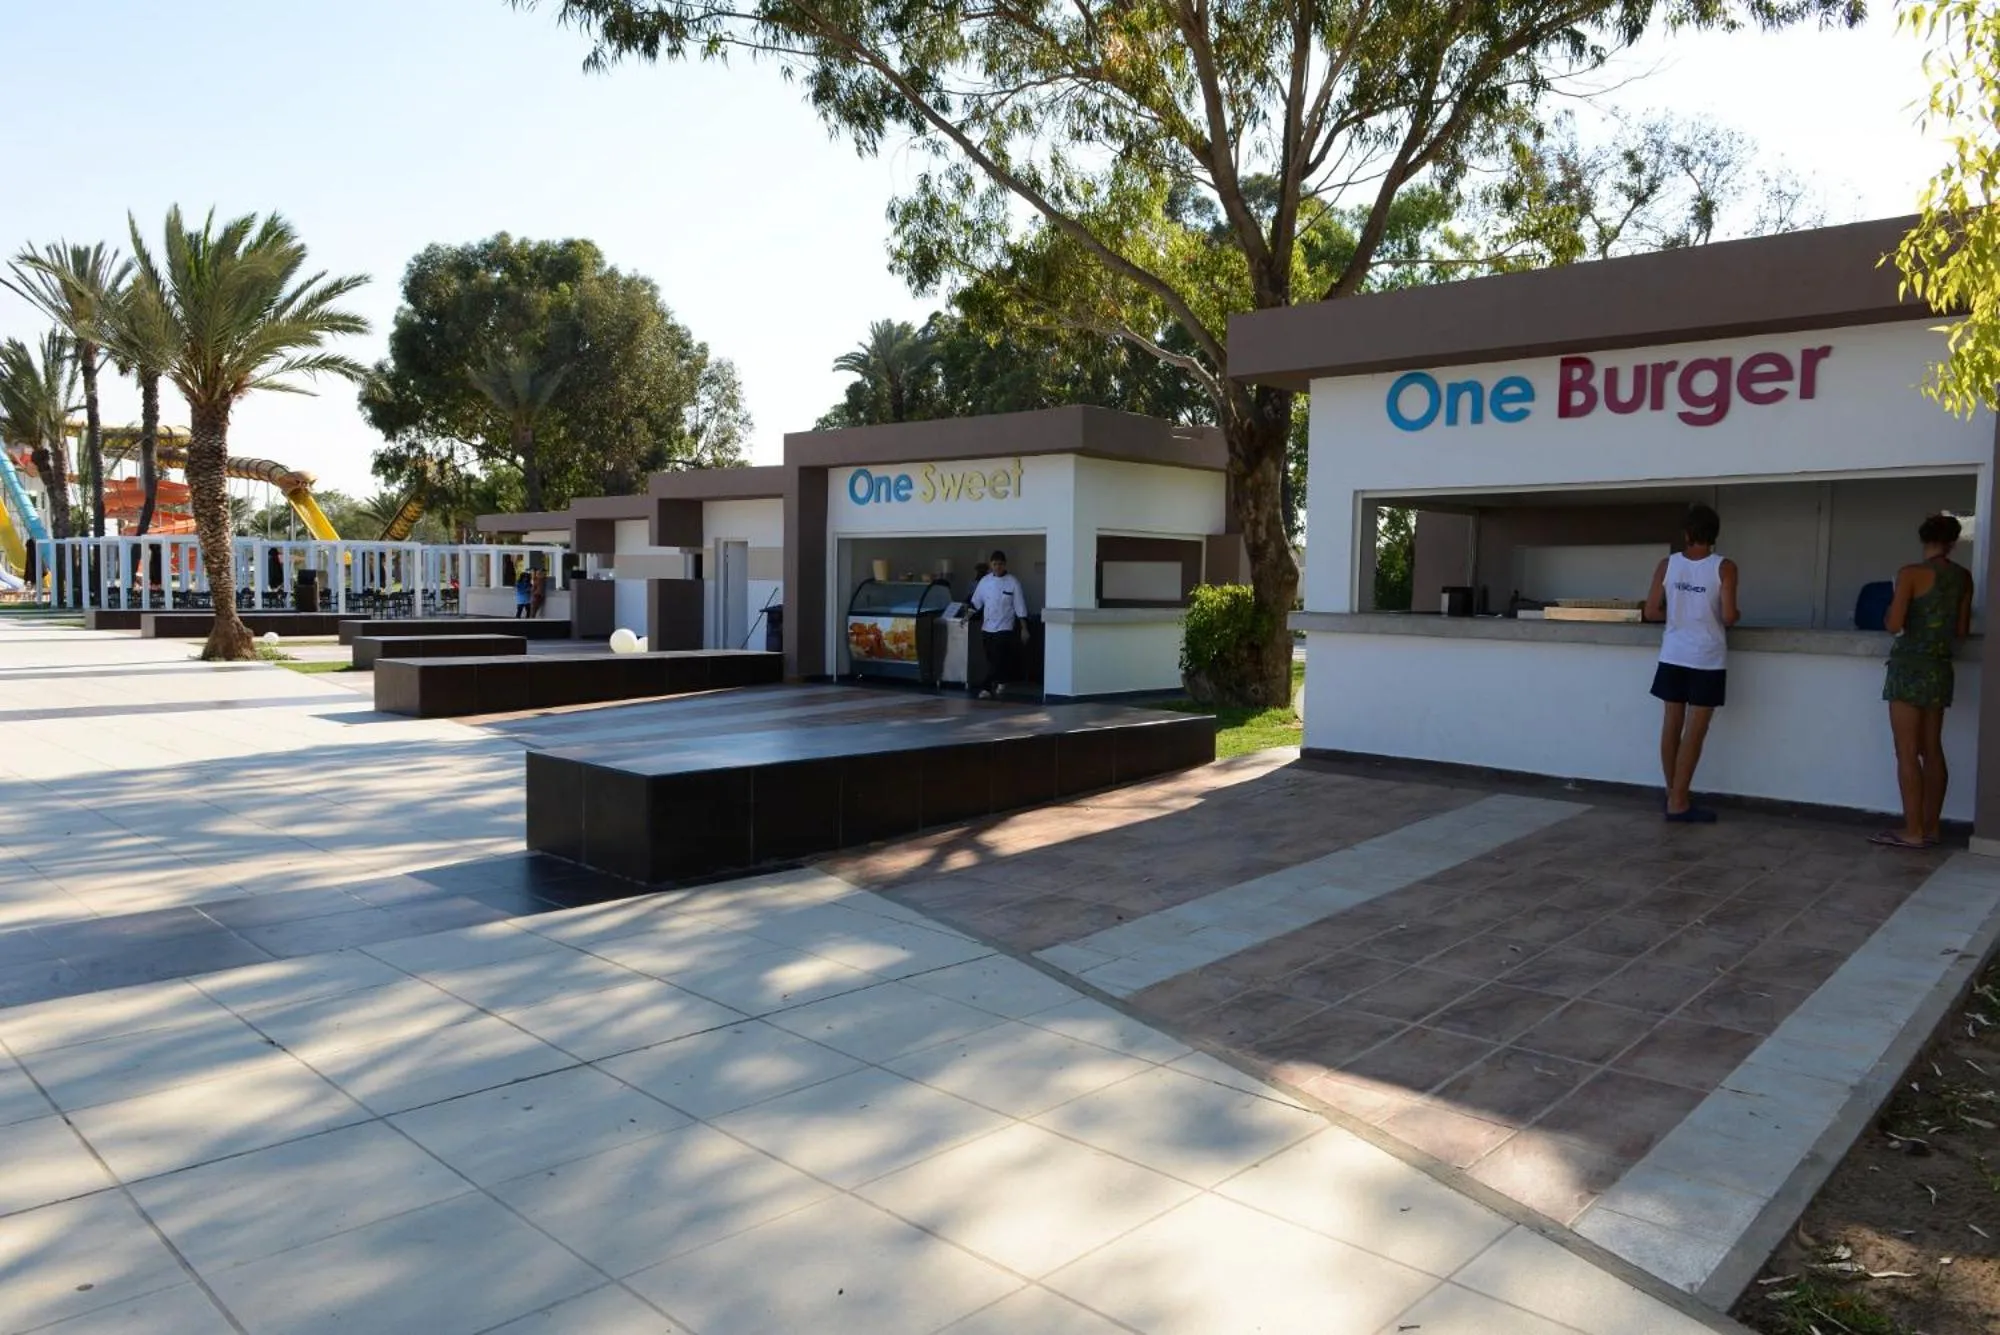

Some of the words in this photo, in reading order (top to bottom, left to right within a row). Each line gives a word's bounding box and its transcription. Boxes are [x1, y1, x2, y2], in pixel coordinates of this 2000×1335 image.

[1386, 372, 1535, 431] One
[1557, 346, 1832, 427] Burger
[849, 468, 913, 506] One
[921, 458, 1024, 504] Sweet
